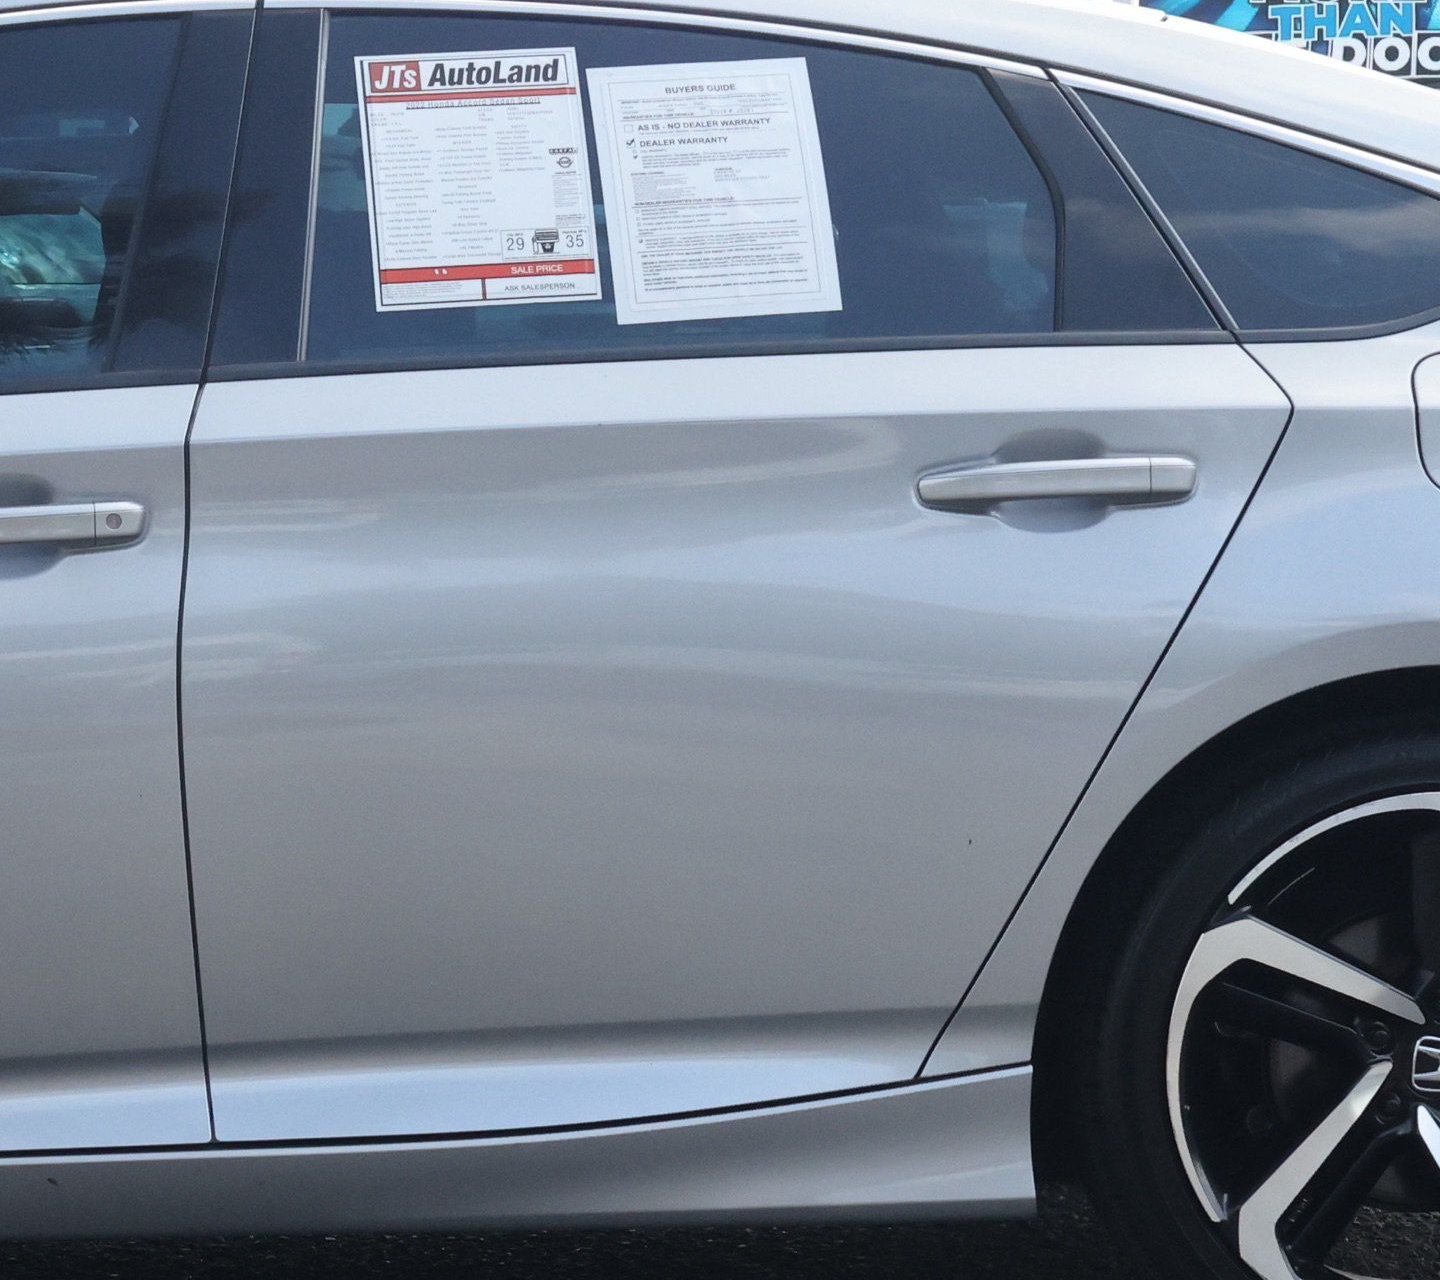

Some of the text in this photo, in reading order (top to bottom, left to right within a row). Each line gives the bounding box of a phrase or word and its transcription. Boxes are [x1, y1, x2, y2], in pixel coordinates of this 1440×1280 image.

[1269, 1, 1416, 41] THAN
[375, 58, 559, 90] JTs AutoLand
[665, 83, 736, 94] BUYERS GUIDE
[651, 123, 660, 131] IS
[683, 120, 719, 129] DEALER
[721, 118, 771, 127] WARRANTY
[639, 136, 728, 147] DEALER WARRANTY
[506, 234, 585, 251] 29 35
[511, 264, 564, 274] SALE PRICE
[520, 282, 576, 291] SALESPERSON
